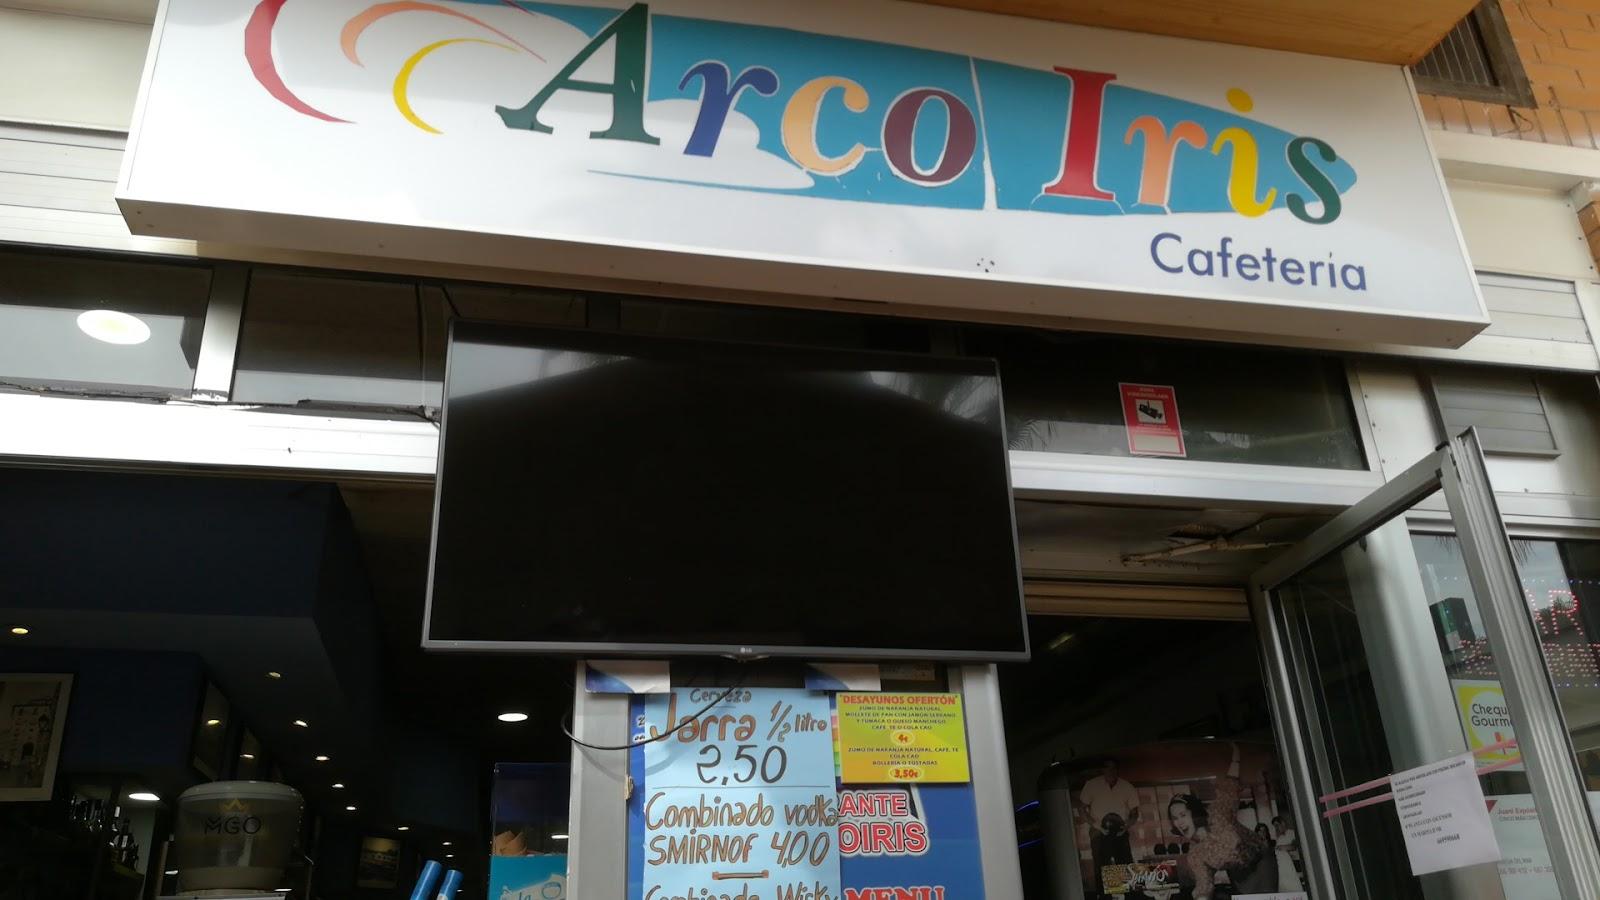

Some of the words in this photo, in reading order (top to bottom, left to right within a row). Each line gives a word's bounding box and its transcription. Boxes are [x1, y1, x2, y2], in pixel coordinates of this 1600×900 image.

[495, 2, 976, 188] Arco
[1044, 65, 1342, 225] Iris
[689, 687, 752, 704] Cerveza
[1471, 703, 1508, 717] Chequ
[649, 692, 756, 743] Jarra
[794, 712, 828, 733] litro
[1471, 715, 1511, 727] Gourm
[696, 745, 788, 786] 2,50
[645, 792, 774, 831] Combinado
[784, 795, 839, 827] vodka
[838, 792, 909, 817] ANTE
[204, 816, 261, 834] MGO
[771, 831, 830, 868] 4,00
